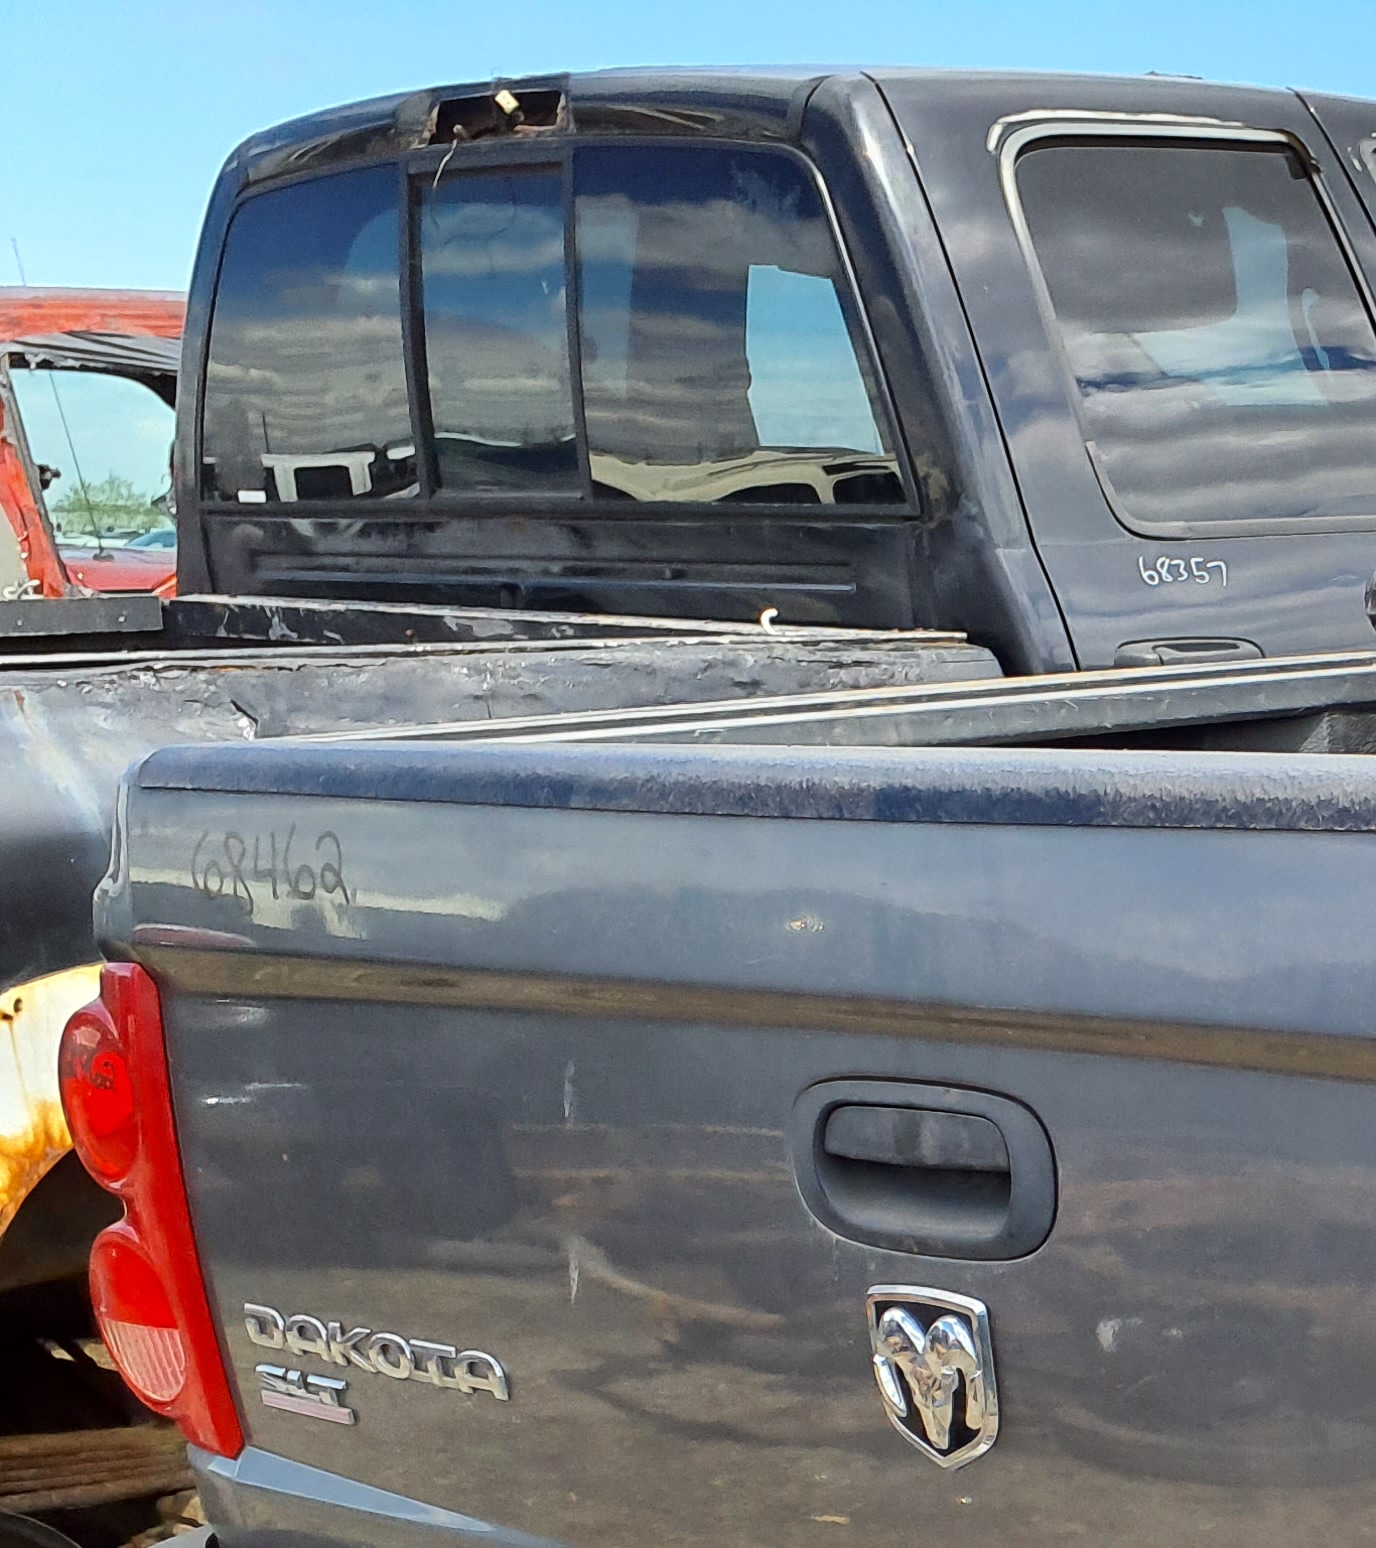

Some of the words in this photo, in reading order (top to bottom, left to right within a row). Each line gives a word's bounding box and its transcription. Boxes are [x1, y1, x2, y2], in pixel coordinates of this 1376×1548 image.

[1138, 556, 1228, 587] 68357
[190, 822, 351, 916] 68462
[243, 1302, 510, 1401] DAKOTA
[254, 1363, 348, 1408] SLT
